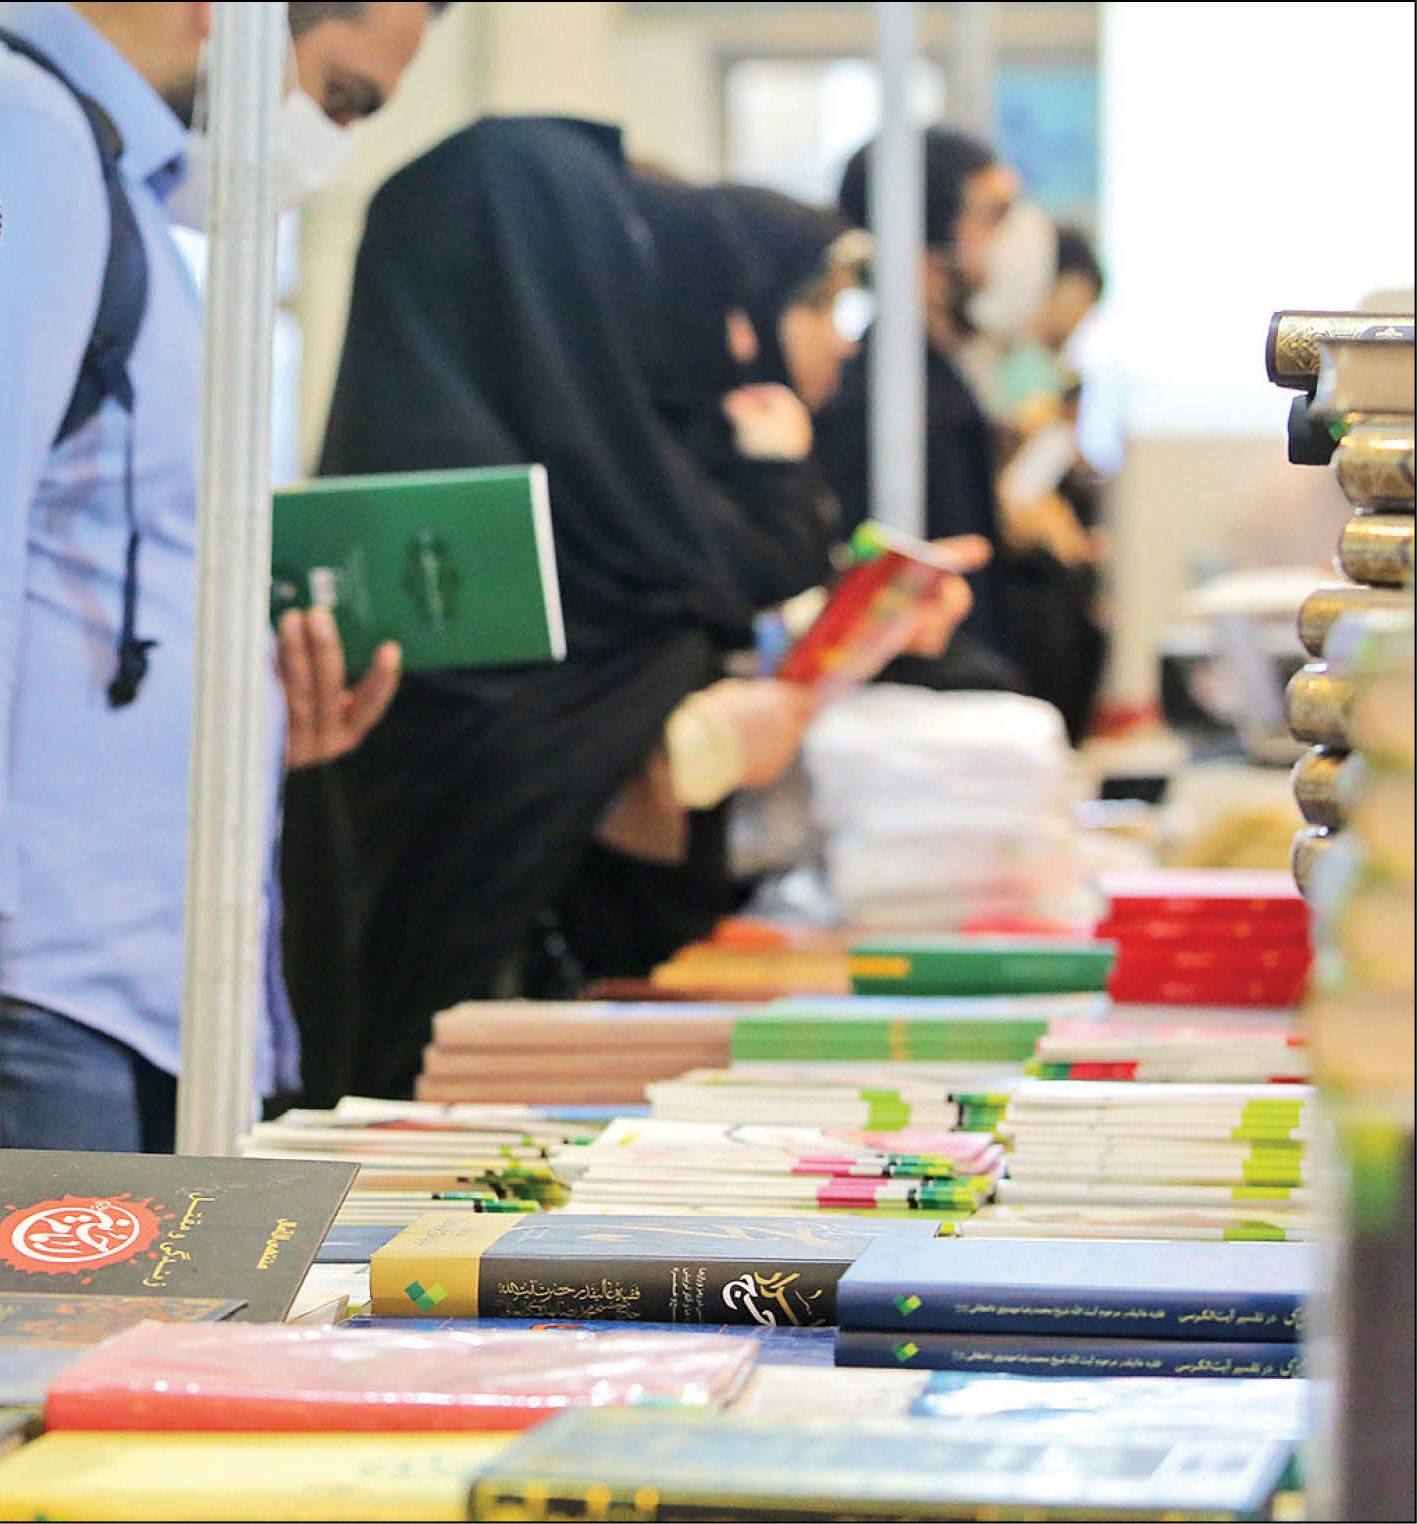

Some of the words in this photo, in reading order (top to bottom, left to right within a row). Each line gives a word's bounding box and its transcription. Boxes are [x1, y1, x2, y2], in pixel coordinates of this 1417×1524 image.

[142, 1241, 191, 1287] زندگی
[167, 1230, 186, 1239] و
[179, 1192, 215, 1231] مقتل
